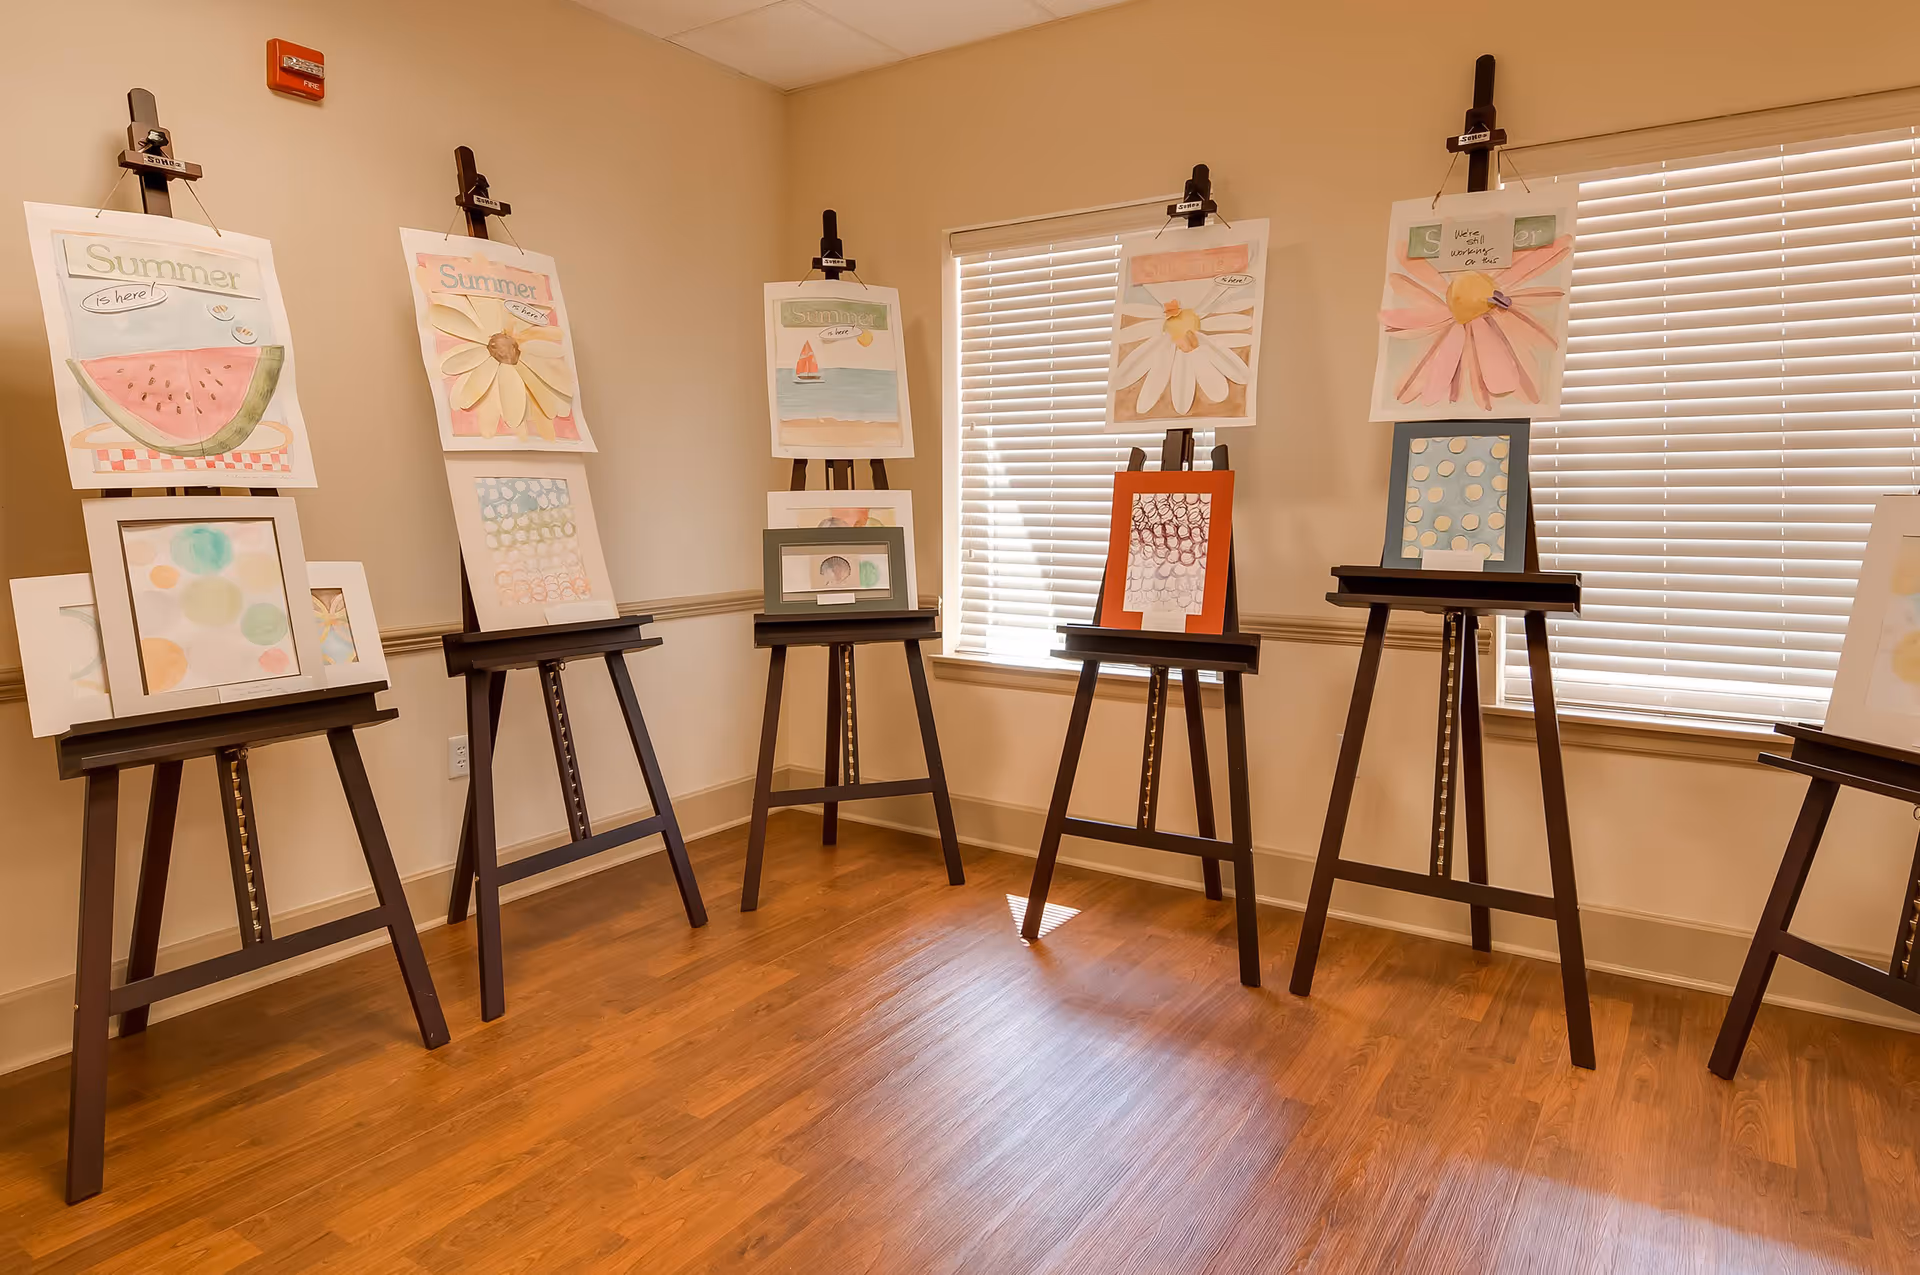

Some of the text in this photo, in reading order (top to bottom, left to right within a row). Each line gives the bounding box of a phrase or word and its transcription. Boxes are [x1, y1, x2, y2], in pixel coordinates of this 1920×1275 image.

[303, 80, 320, 90] FIRE
[1454, 228, 1480, 240] We're
[1466, 235, 1485, 245] still
[1450, 247, 1495, 257] working
[86, 243, 241, 290] Summer
[439, 263, 537, 300] Summer
[96, 281, 156, 307] is here!
[792, 306, 878, 326] Summer
